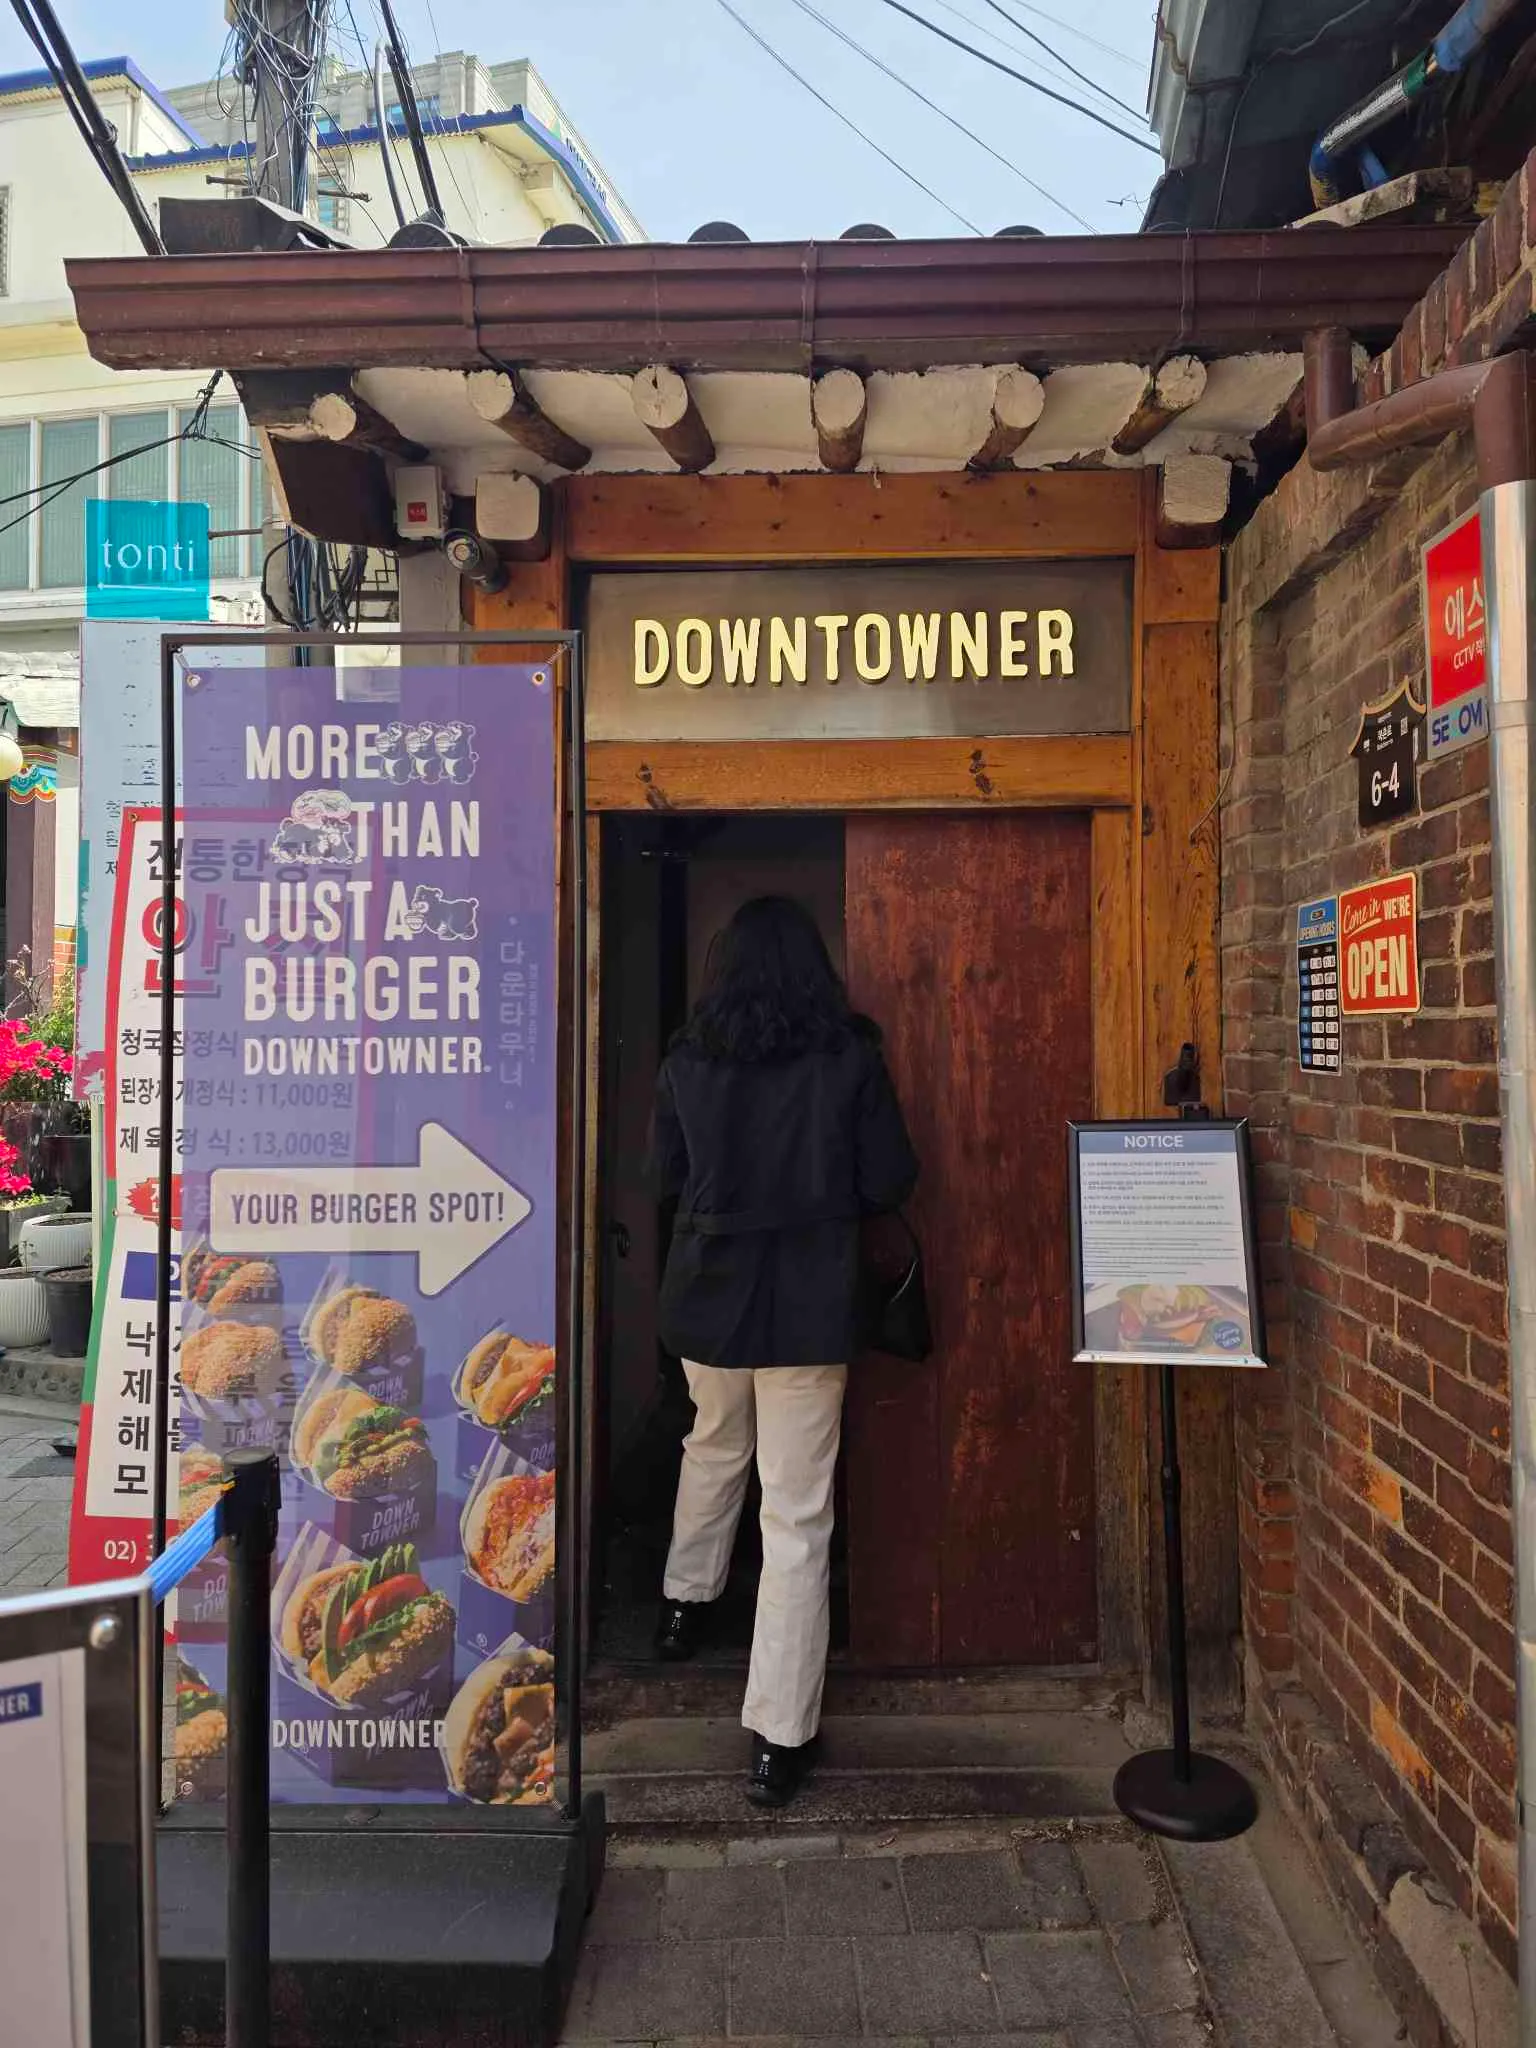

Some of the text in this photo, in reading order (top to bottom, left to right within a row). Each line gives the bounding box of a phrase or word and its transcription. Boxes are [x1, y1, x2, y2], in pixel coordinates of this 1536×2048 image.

[102, 538, 194, 571] tonti
[634, 609, 1074, 686] DOWNTOWNER
[246, 724, 380, 780] MORE
[1371, 761, 1400, 808] 6-4
[351, 801, 480, 857] THAN
[245, 881, 413, 943] JUST A
[1343, 905, 1368, 934] Come
[1382, 894, 1410, 920] WE'RE
[244, 956, 480, 1022] BURGER
[1347, 934, 1409, 1000] OPEN
[1123, 1135, 1184, 1149] NOTICE
[231, 1194, 298, 1224] YOUR
[310, 1192, 417, 1224] BURGER
[429, 1191, 504, 1223] SPOT!
[104, 1541, 137, 1563] 02)
